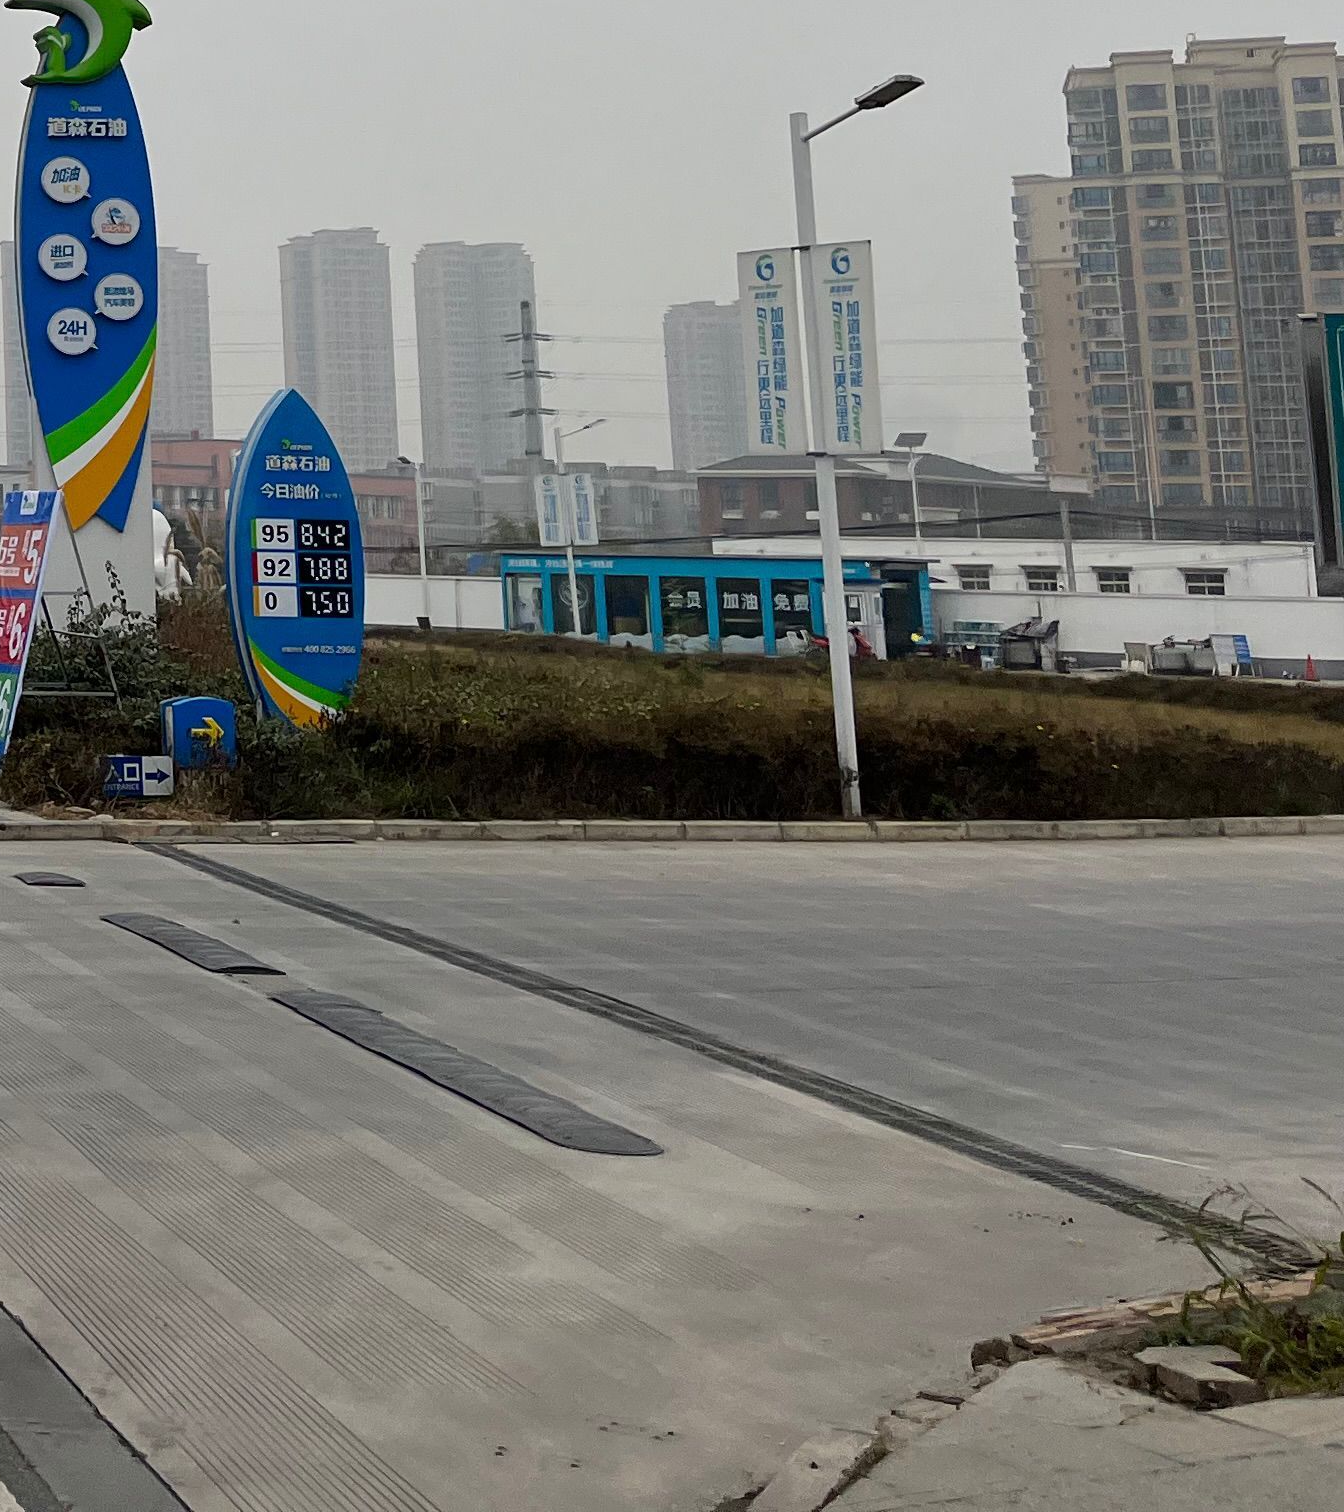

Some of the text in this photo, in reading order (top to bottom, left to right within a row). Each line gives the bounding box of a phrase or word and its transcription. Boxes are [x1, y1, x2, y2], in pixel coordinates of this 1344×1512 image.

[47, 117, 128, 137] 道森石油
[51, 165, 81, 184] 加油
[50, 244, 74, 258] 进口
[57, 320, 88, 336] 24H
[756, 307, 768, 356] Green
[831, 301, 843, 352] Green
[757, 359, 775, 445] 行更远里程
[832, 355, 851, 444] 行更远里程
[774, 396, 788, 450] Power
[850, 393, 863, 450] Power
[265, 455, 331, 472] 道森石油
[260, 483, 320, 500] 今日油价
[261, 523, 346, 548] 95 8.42
[263, 557, 348, 581] 92 7.88
[264, 591, 350, 615] 0 7.50
[666, 591, 810, 612] 会员 加油 免费
[104, 762, 141, 783] 入口
[103, 783, 140, 791] ENTRANCE
